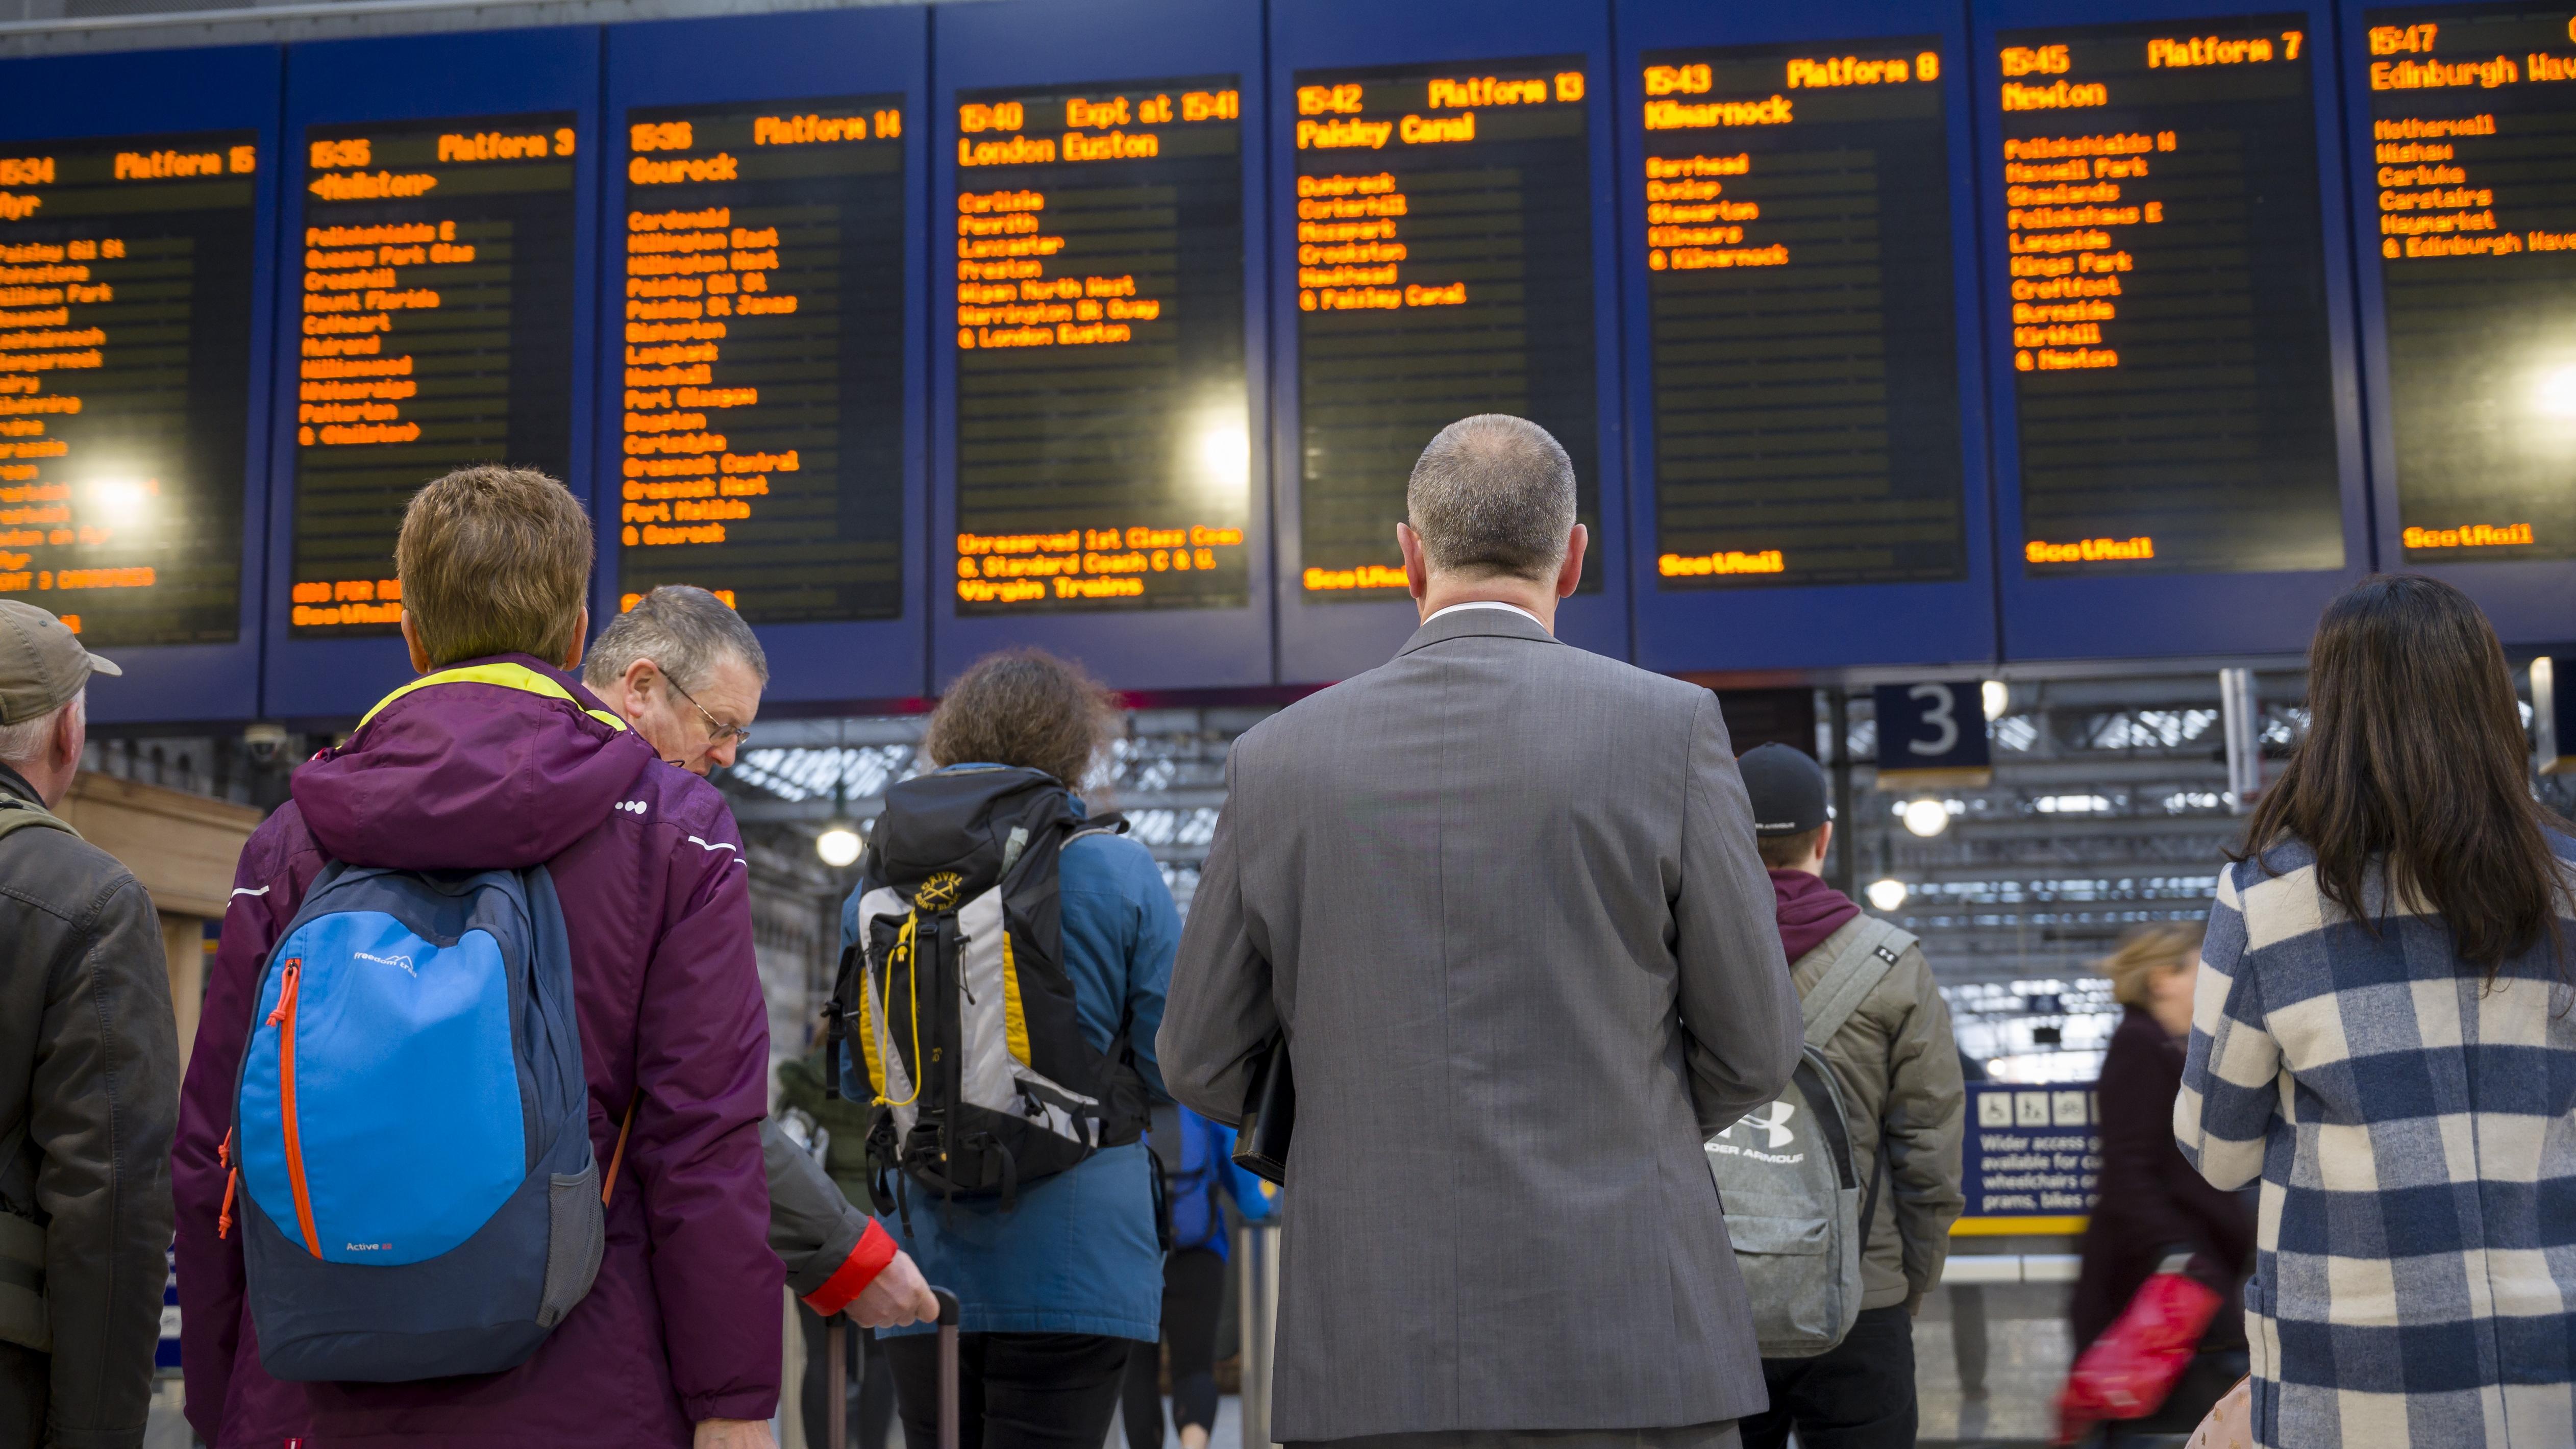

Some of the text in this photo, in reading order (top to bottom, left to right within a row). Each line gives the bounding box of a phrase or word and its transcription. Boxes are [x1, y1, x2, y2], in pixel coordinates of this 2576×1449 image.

[2369, 24, 2438, 55] 15:47
[2000, 31, 2302, 76] 15:45 Platform 7
[1644, 52, 1939, 95] 15:43 Platform 8
[2371, 55, 2518, 90] Edinburgh
[1297, 72, 1584, 115] 15:42 Platform 13
[2002, 80, 2107, 111] Newton
[959, 90, 1239, 132] 15:40 Expt at 15:41
[1644, 95, 1793, 130] Kilmarnock
[754, 114, 866, 145] Platform
[874, 110, 901, 138] 14
[1297, 112, 1475, 149] Paisley Canal
[2374, 114, 2496, 140] Motherwell
[438, 133, 547, 161] Platform
[555, 129, 575, 156] 3
[958, 130, 1158, 166] London Euston
[2376, 142, 2453, 163] Wishaw
[115, 151, 221, 179] Platform
[230, 146, 255, 172] 15
[629, 153, 737, 184] Gourock
[2094, 156, 2148, 179] Park
[2378, 164, 2465, 187] Carluke
[958, 190, 1044, 213] Carlisle
[2380, 187, 2493, 210] Carstairs
[2381, 210, 2496, 235] Haymarket
[2010, 229, 2111, 253] Langside
[2406, 233, 2522, 257] Edinburgh
[958, 258, 1043, 281] Preston
[2078, 251, 2133, 273] Park
[1021, 278, 1082, 300] North
[1085, 275, 1135, 297] West
[1321, 286, 1402, 310] Paisley
[1405, 282, 1467, 306] Canal
[979, 326, 1054, 348] London
[1057, 321, 1131, 344] Euston
[1125, 526, 1186, 549] Class
[2403, 523, 2534, 548] ScotRail
[2025, 537, 2154, 563] ScotRail
[982, 553, 1080, 578] Standard
[1083, 551, 1148, 574] Coach
[957, 575, 1144, 602] Virgin Trains
[1908, 684, 1959, 756] 3
[921, 872, 962, 890] GRIVEL
[914, 893, 935, 911] MONT
[354, 952, 417, 978] freedom trail
[1704, 1142, 1804, 1164] NDER ARMOUR
[1979, 1134, 2029, 1152] Wider
[2033, 1136, 2085, 1152] access
[1981, 1153, 2050, 1170] available
[2053, 1152, 2078, 1169] for
[1982, 1172, 2078, 1189] wheelchairs
[1983, 1194, 2037, 1213] prams,
[2041, 1191, 2083, 1209] bikes
[347, 1243, 379, 1251] Active
